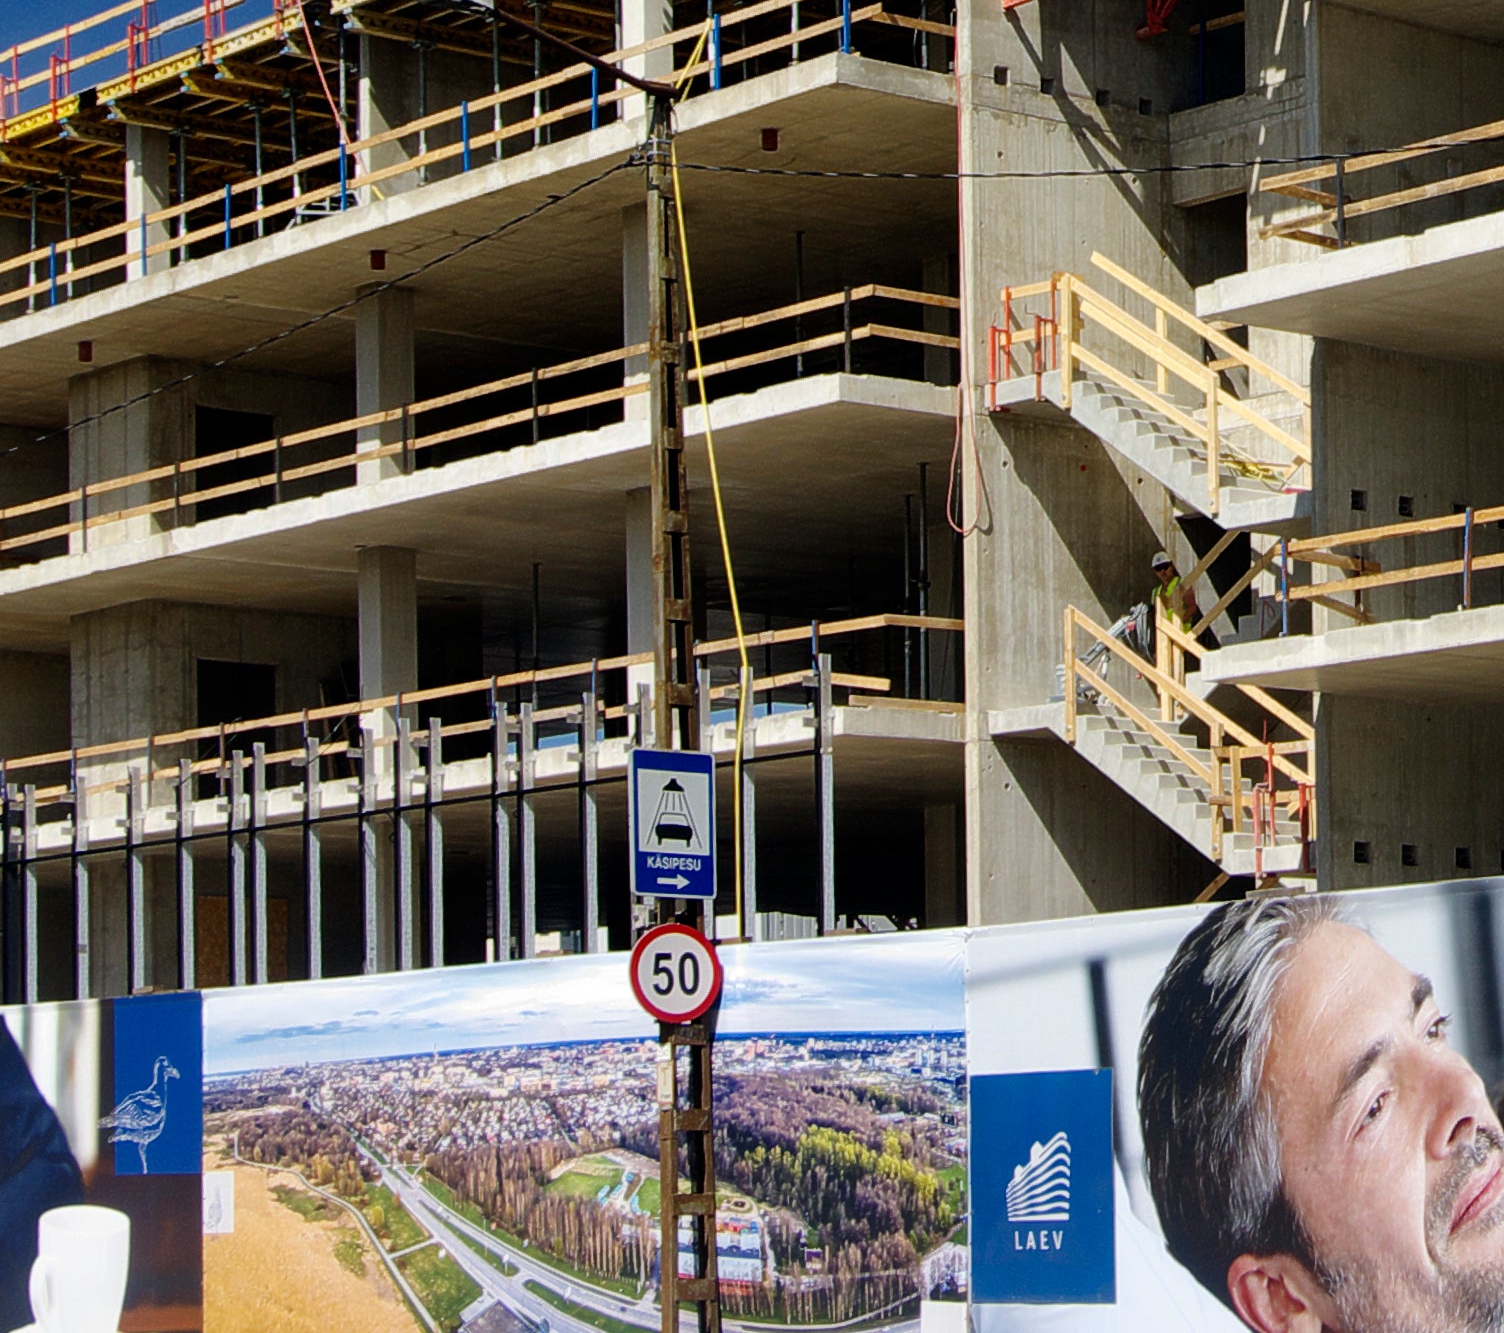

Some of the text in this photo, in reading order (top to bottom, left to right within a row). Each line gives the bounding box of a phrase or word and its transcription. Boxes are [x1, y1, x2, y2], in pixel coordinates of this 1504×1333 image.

[646, 854, 702, 872] KÄSIPESU
[653, 952, 699, 996] 50
[1014, 1230, 1064, 1250] LAEV
